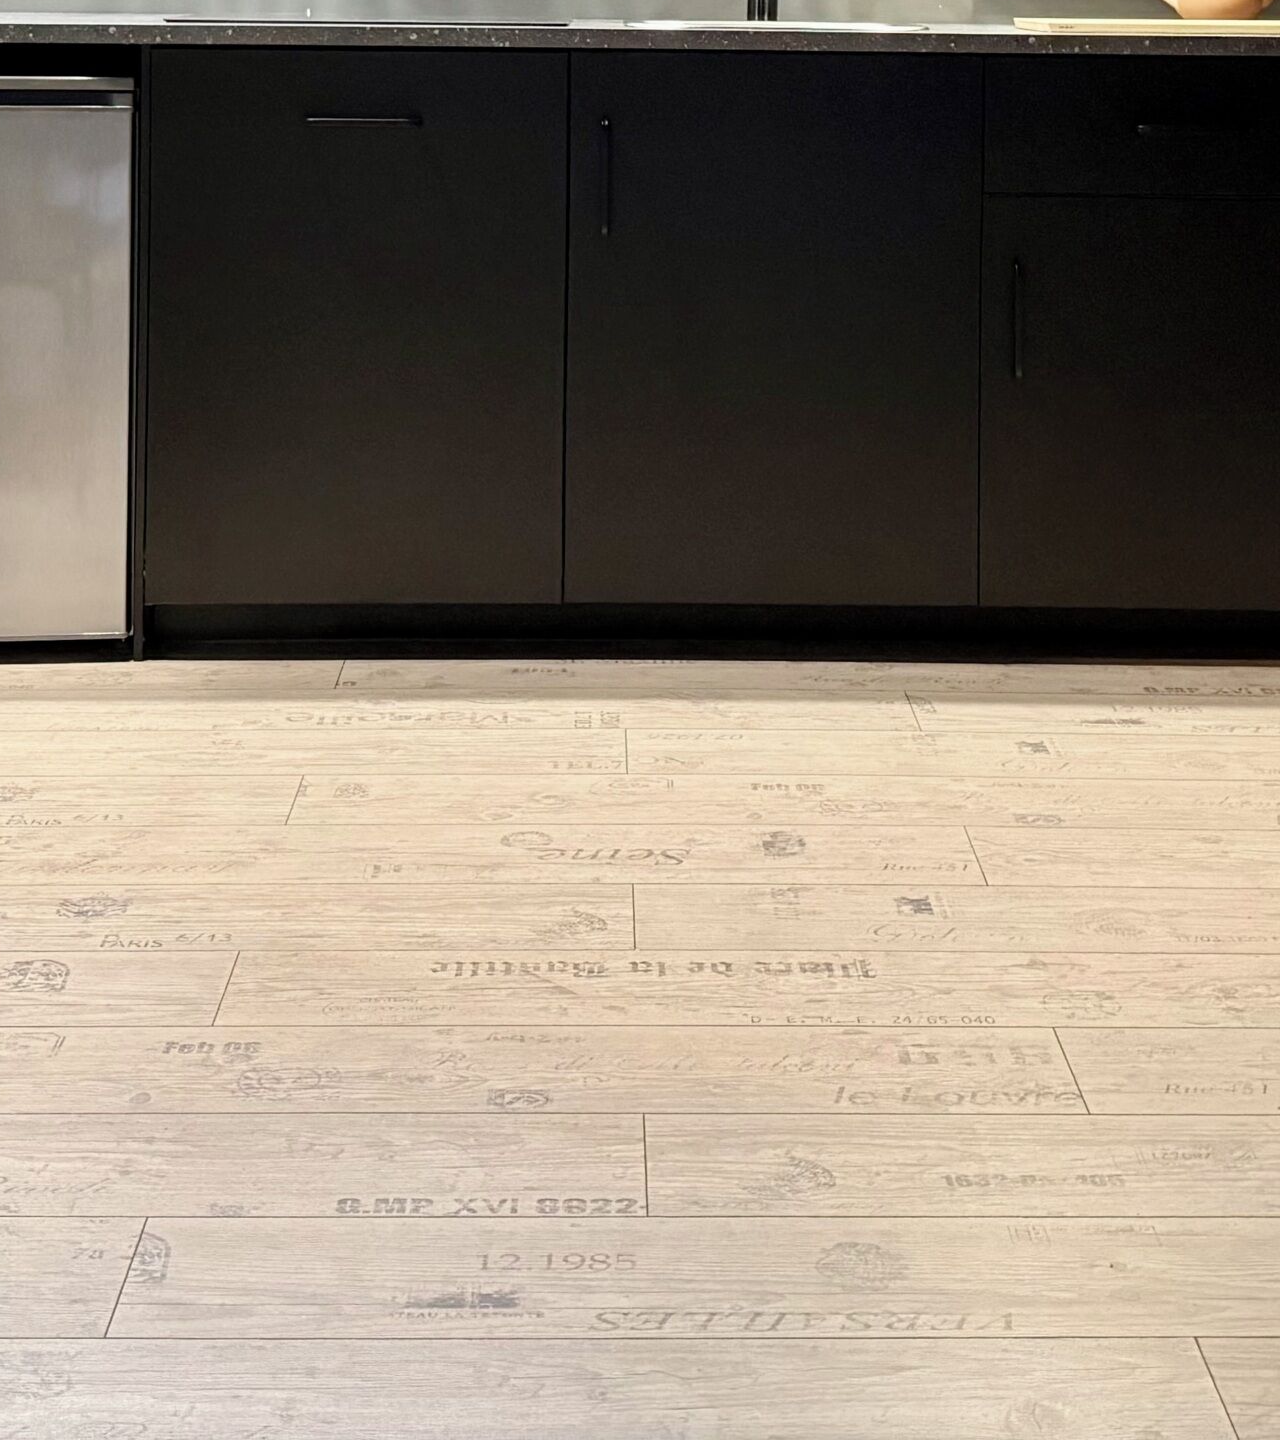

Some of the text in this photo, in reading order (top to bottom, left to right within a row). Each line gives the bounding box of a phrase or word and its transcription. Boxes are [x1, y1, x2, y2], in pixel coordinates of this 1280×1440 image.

[523, 847, 692, 866] Seine
[99, 932, 234, 949] PARIS 6/13
[833, 1085, 877, 1106] le
[476, 1252, 639, 1272] 12.1985
